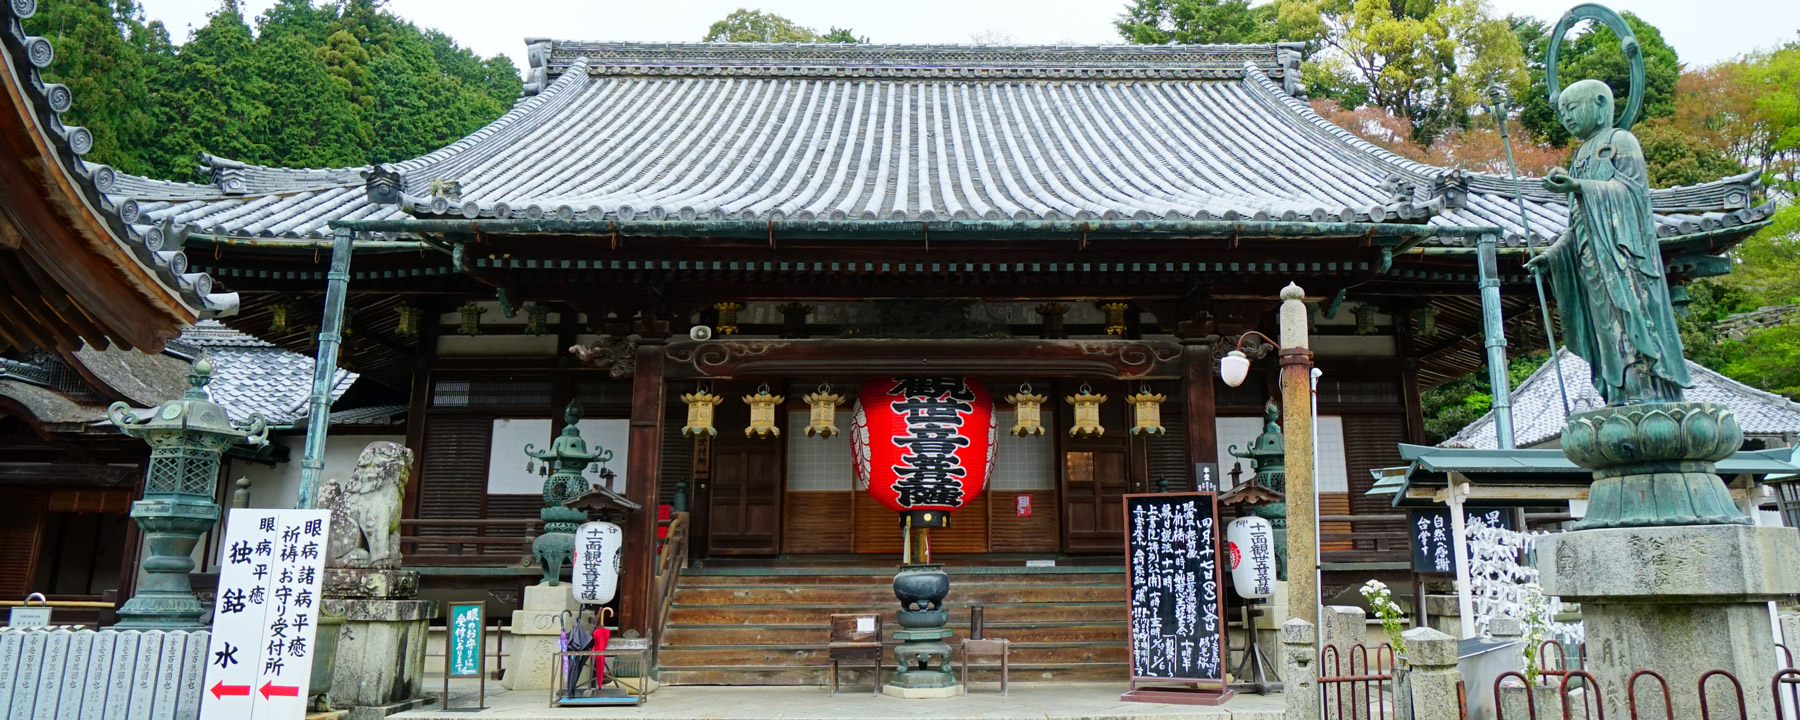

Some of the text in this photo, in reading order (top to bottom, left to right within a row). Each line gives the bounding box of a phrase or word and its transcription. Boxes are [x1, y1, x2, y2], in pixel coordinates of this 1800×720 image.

[248, 516, 276, 605] 眼病平癒
[606, 524, 618, 534] 谷
[1248, 522, 1271, 595] 十一面観世音菩薩
[1433, 514, 1450, 571] 自然へ感謝
[287, 518, 323, 658] 眼病諸病平癒
[581, 528, 604, 601] 十一面観世音菩薩
[1161, 557, 1174, 593] 十一時
[213, 540, 254, 669] 独鈷水
[465, 607, 480, 667] 眼のお守りは
[455, 613, 467, 673] 受付にあります
